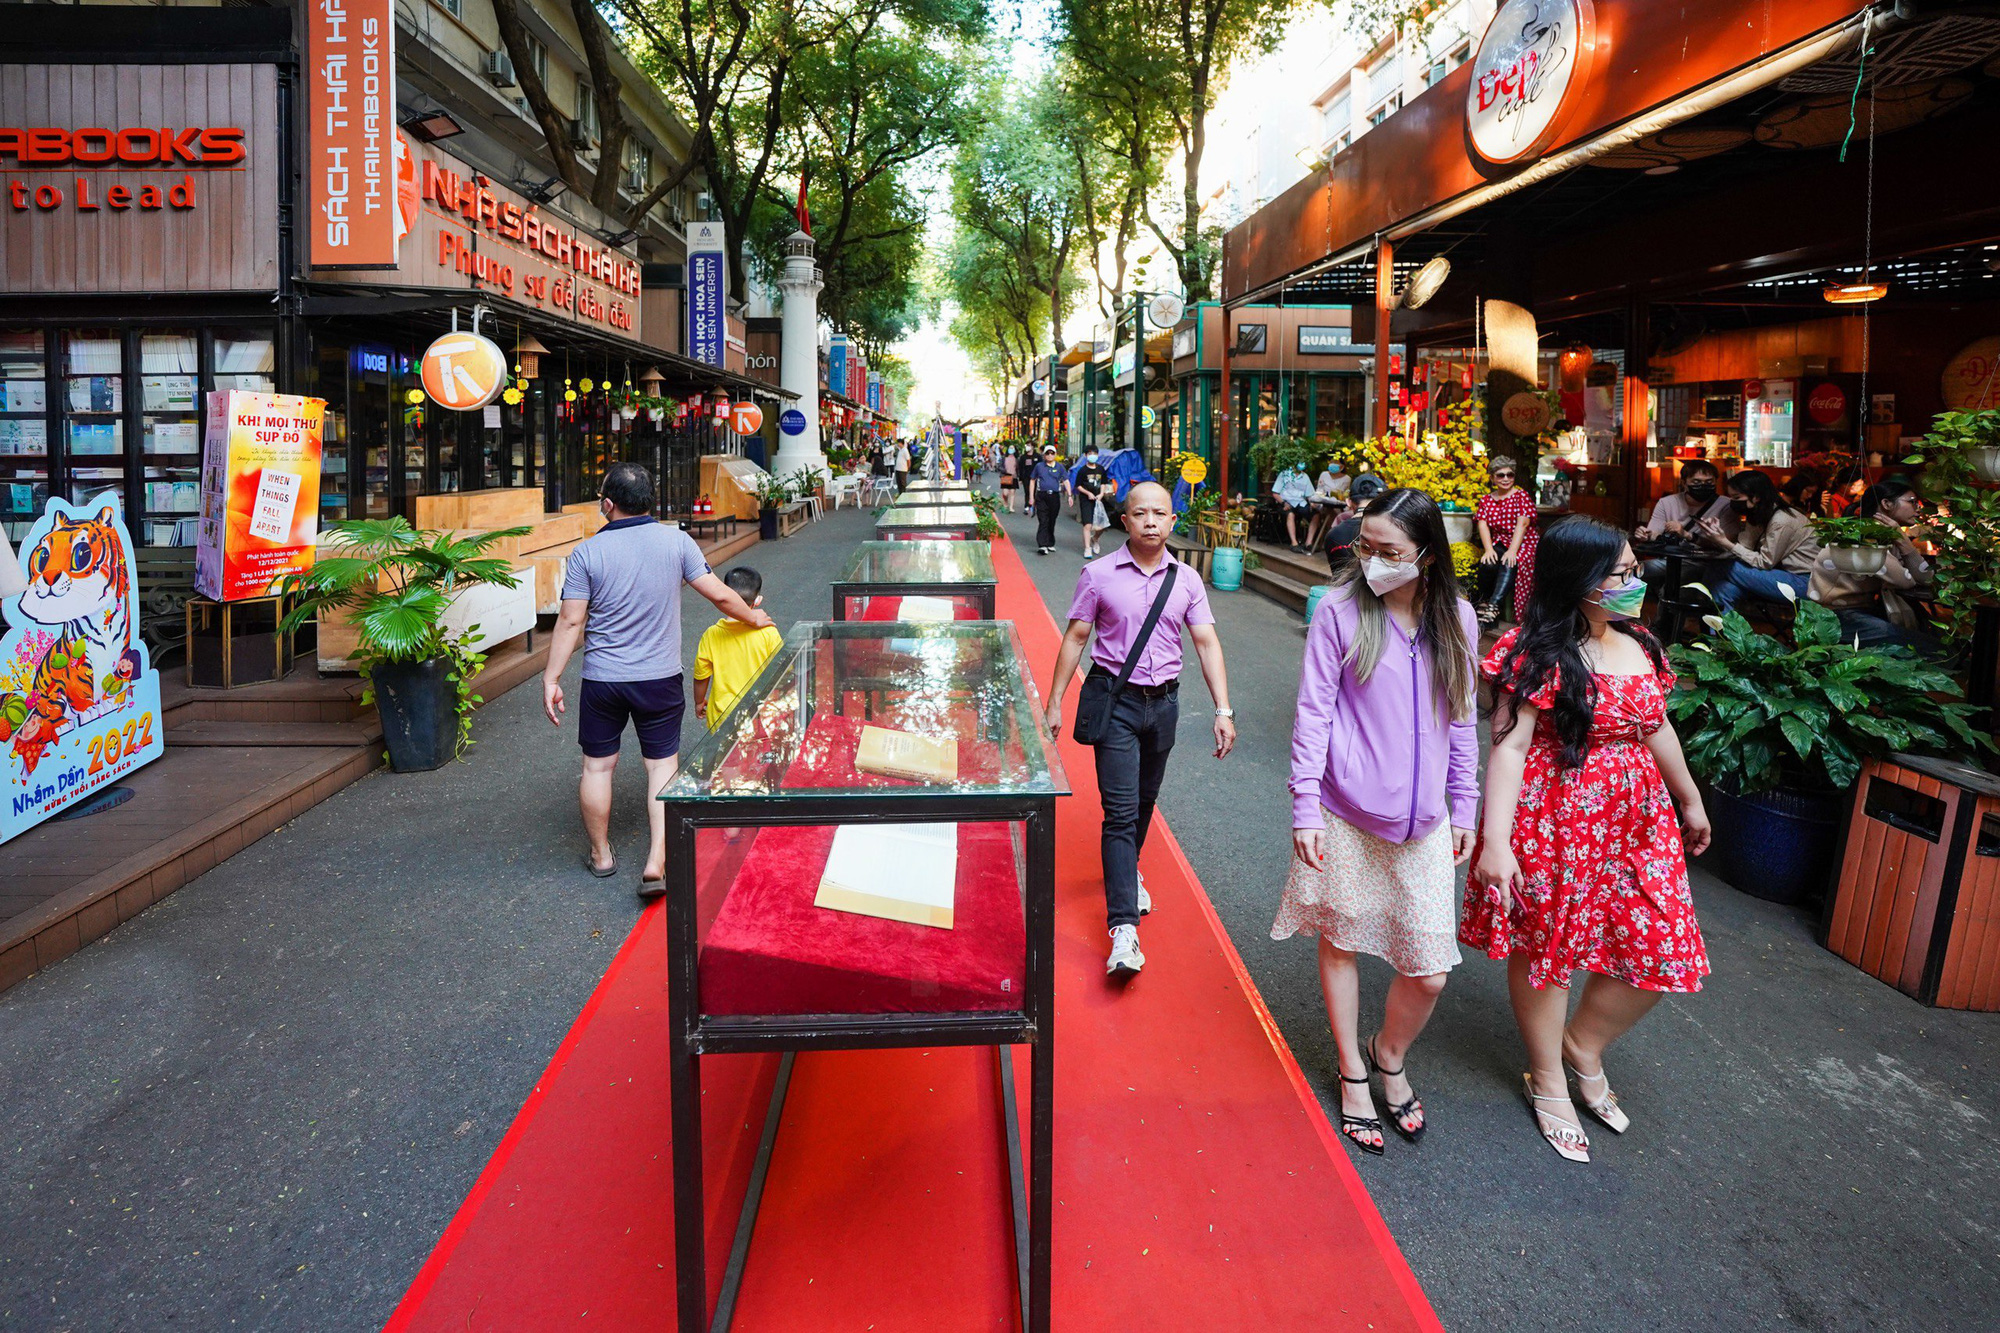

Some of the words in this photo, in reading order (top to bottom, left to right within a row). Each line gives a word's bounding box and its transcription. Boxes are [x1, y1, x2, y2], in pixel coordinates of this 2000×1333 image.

[321, 54, 348, 137] THÁI
[362, 18, 380, 215] THAIHABOOKS
[9, 180, 63, 210] to
[77, 175, 197, 210] Lead
[322, 147, 349, 247] SÁCH
[422, 160, 498, 230] NHÀ
[498, 204, 571, 265] SÁCH
[571, 240, 620, 288] THÁI
[619, 261, 641, 298] HÀ
[439, 230, 514, 297] Phụng
[524, 273, 547, 309] sự
[552, 275, 574, 311] để
[578, 287, 604, 321] dẫn
[609, 301, 632, 331] đầu
[695, 258, 705, 281] SEN
[696, 284, 706, 311] HOA
[707, 258, 716, 317] UNIVERSITY
[696, 313, 708, 341] HỌC
[708, 319, 717, 340] SEN
[708, 341, 717, 365] HOA
[238, 415, 261, 427] KHI
[265, 416, 289, 431] MỌI
[293, 416, 318, 430] THỨ
[255, 431, 280, 445] SỤP
[283, 429, 300, 443] ĐỔ
[267, 473, 291, 486] WHEN
[261, 488, 290, 503] THINGS
[262, 506, 280, 518] FALL
[256, 521, 282, 535] APART
[258, 558, 289, 567] 12/12/2021
[87, 711, 153, 776] 2022
[12, 784, 55, 817] Nhâm
[58, 765, 85, 793] Dần
[44, 794, 67, 813] MỪNG
[70, 781, 89, 799] TUỔI
[91, 772, 110, 788] BẰNG
[113, 761, 131, 776] SÁCH
